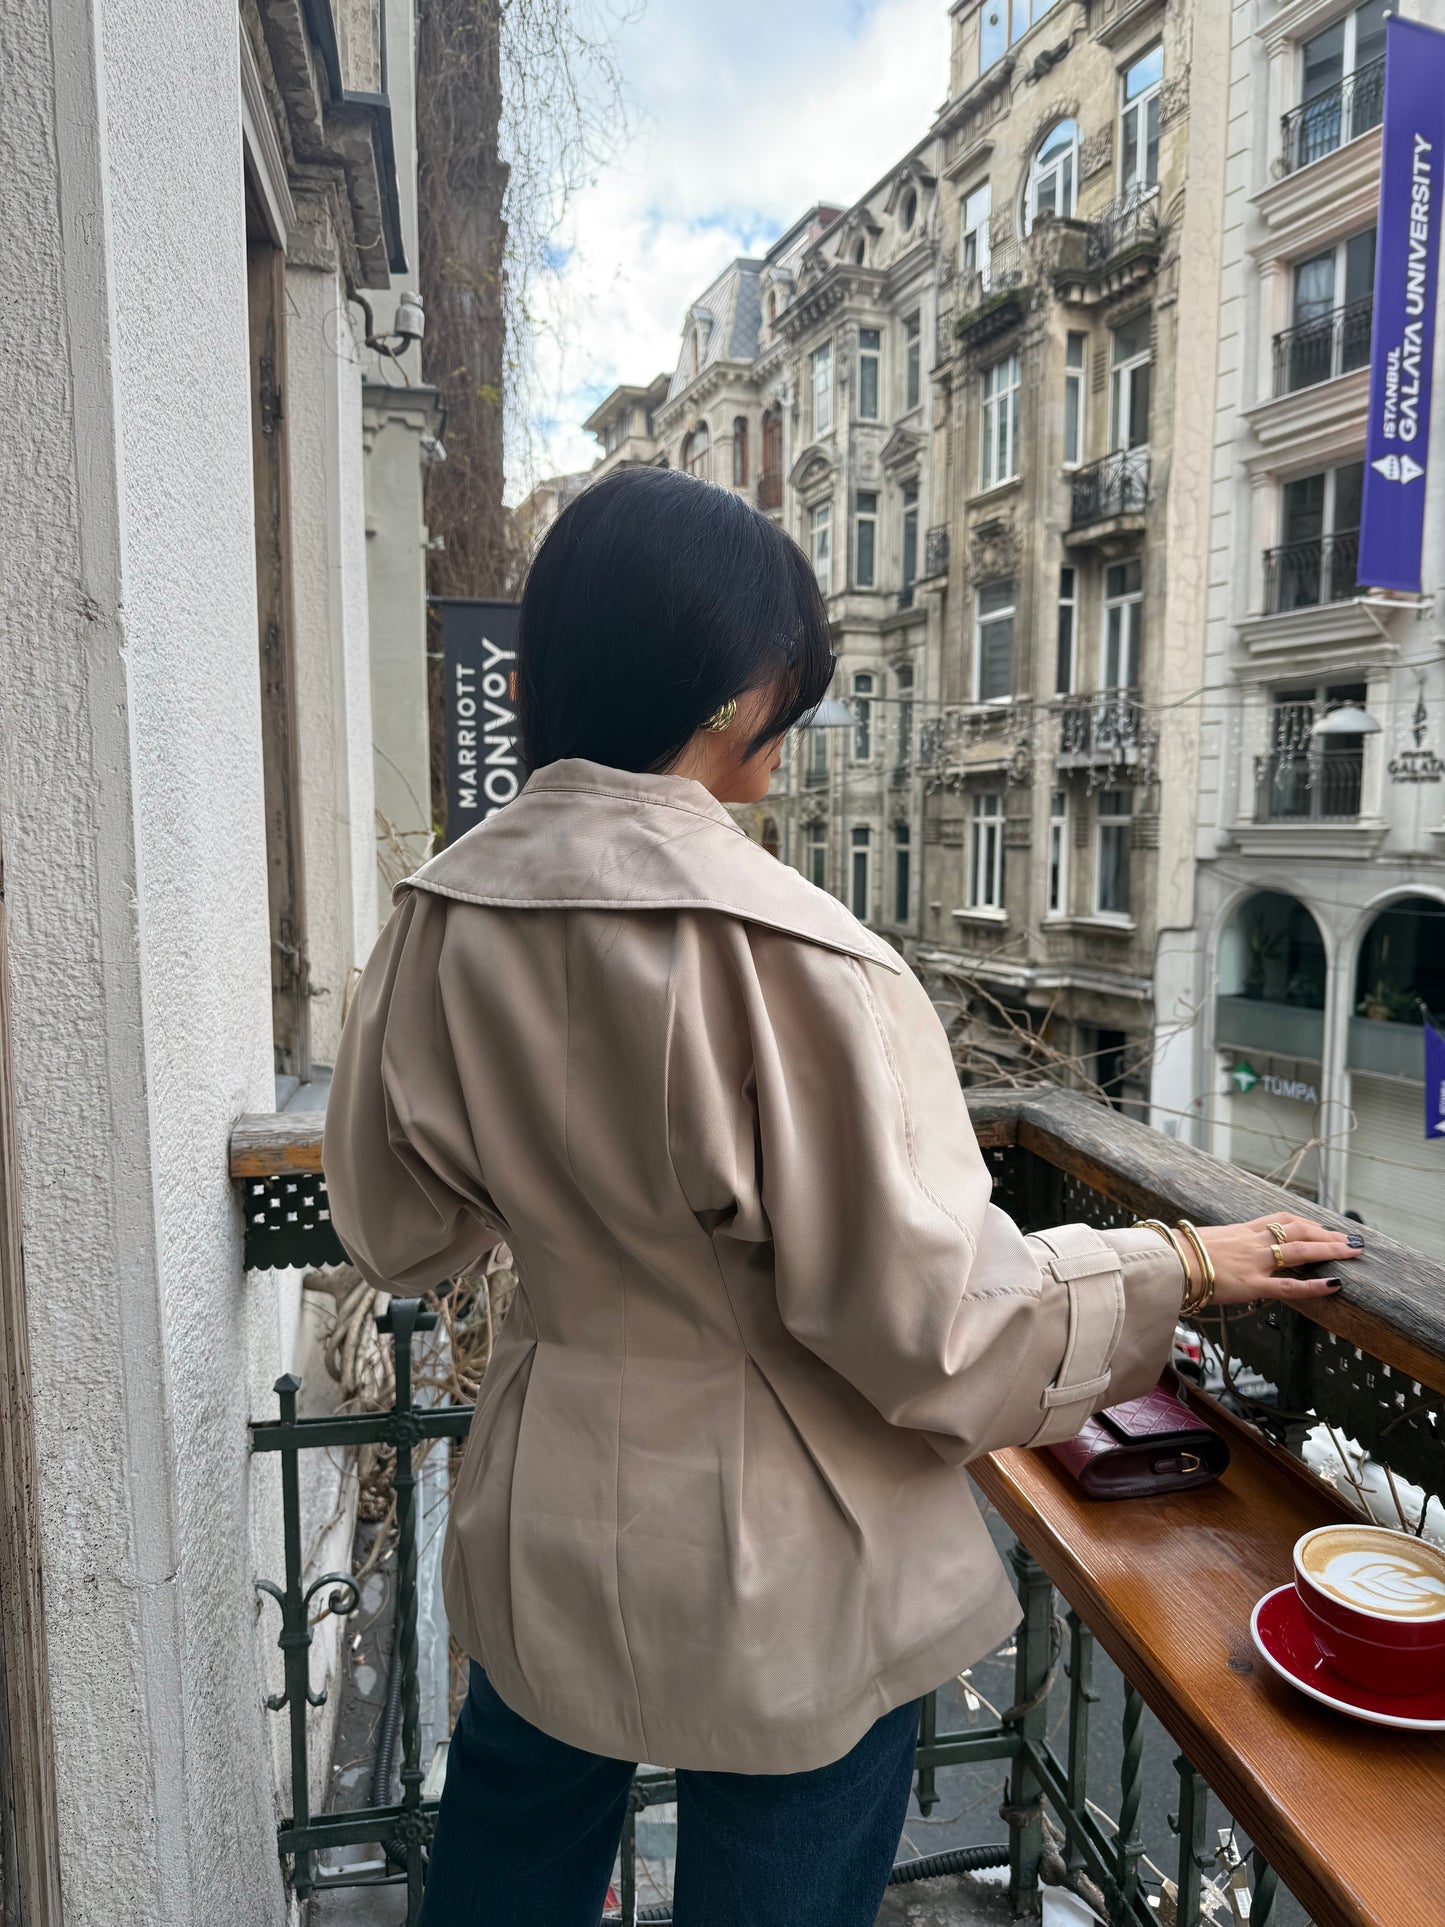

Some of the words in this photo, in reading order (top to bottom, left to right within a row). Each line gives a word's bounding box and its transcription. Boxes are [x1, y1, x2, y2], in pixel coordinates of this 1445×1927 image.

[1405, 132, 1433, 316] UNIVERSITY
[1383, 346, 1401, 439] ISTANBUL
[1398, 321, 1424, 442] GALATA
[456, 662, 478, 809] MARRIOTT
[482, 636, 519, 818] ONVOY
